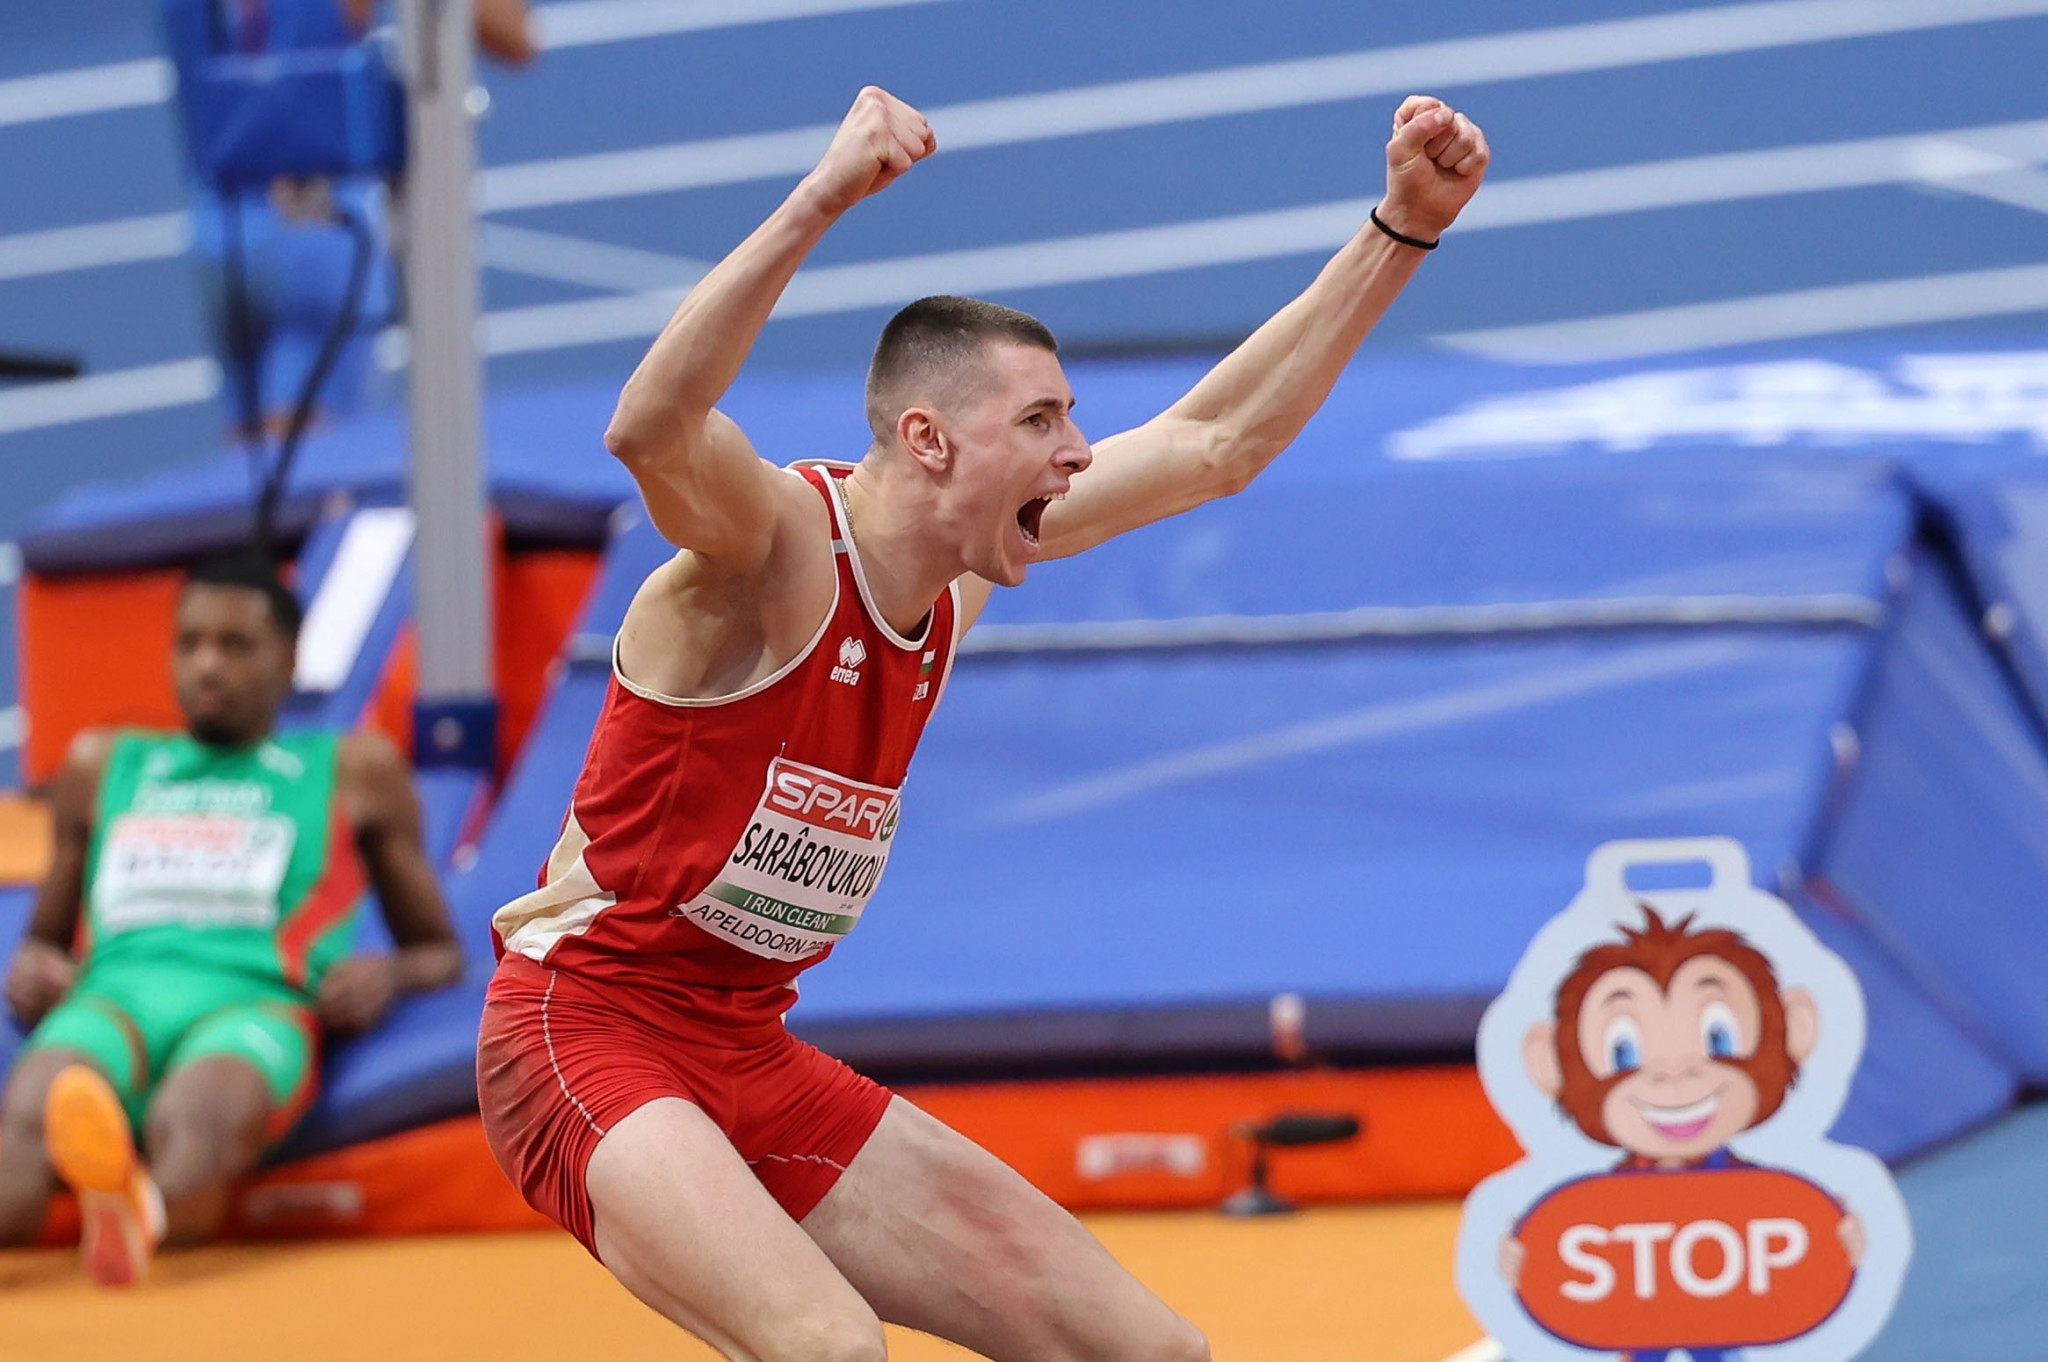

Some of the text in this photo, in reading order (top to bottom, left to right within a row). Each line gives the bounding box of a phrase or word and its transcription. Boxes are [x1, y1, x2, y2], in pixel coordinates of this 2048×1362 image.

[830, 666, 860, 686] errea
[772, 772, 887, 833] SPAR
[732, 822, 886, 898] SARÂBOYUKOV
[691, 904, 808, 955] APELDOORN
[742, 894, 754, 907] I
[751, 896, 789, 919] RUN
[1557, 1218, 1810, 1303] STOP
